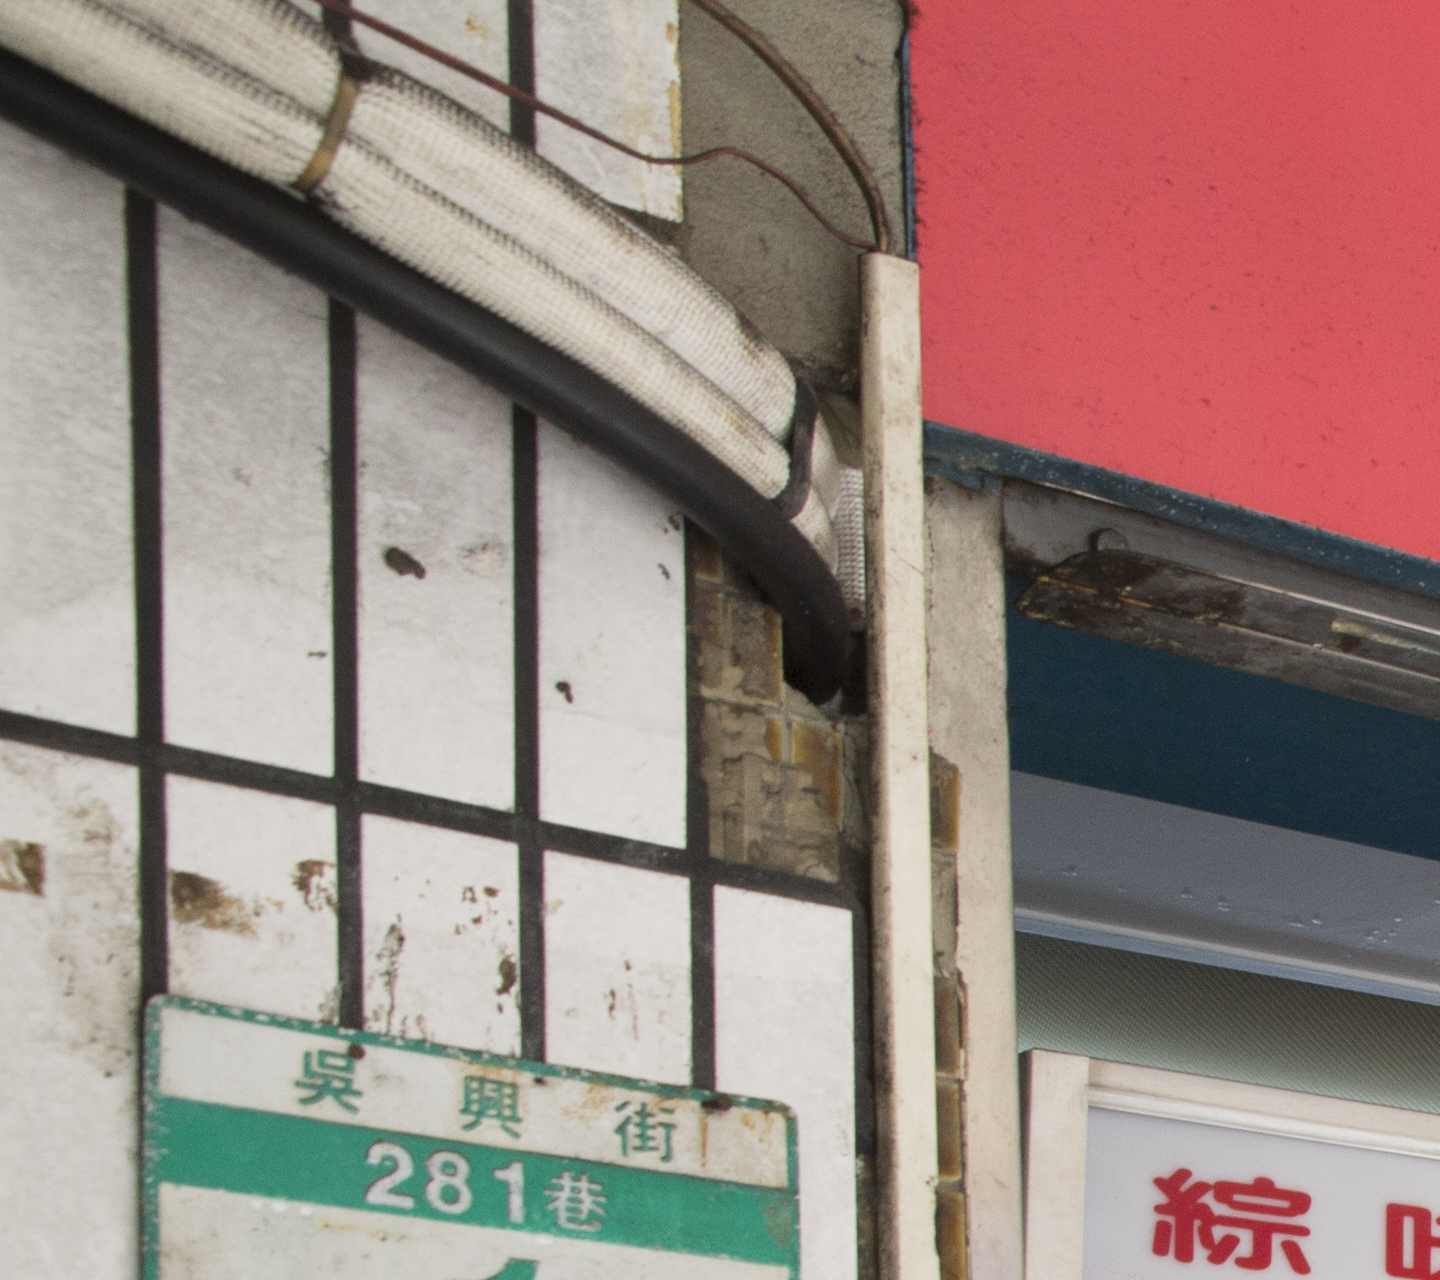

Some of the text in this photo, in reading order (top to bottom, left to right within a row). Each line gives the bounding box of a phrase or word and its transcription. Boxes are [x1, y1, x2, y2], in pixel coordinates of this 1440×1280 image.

[294, 1048, 677, 1162] 吳興街
[365, 1141, 606, 1231] 281巷
